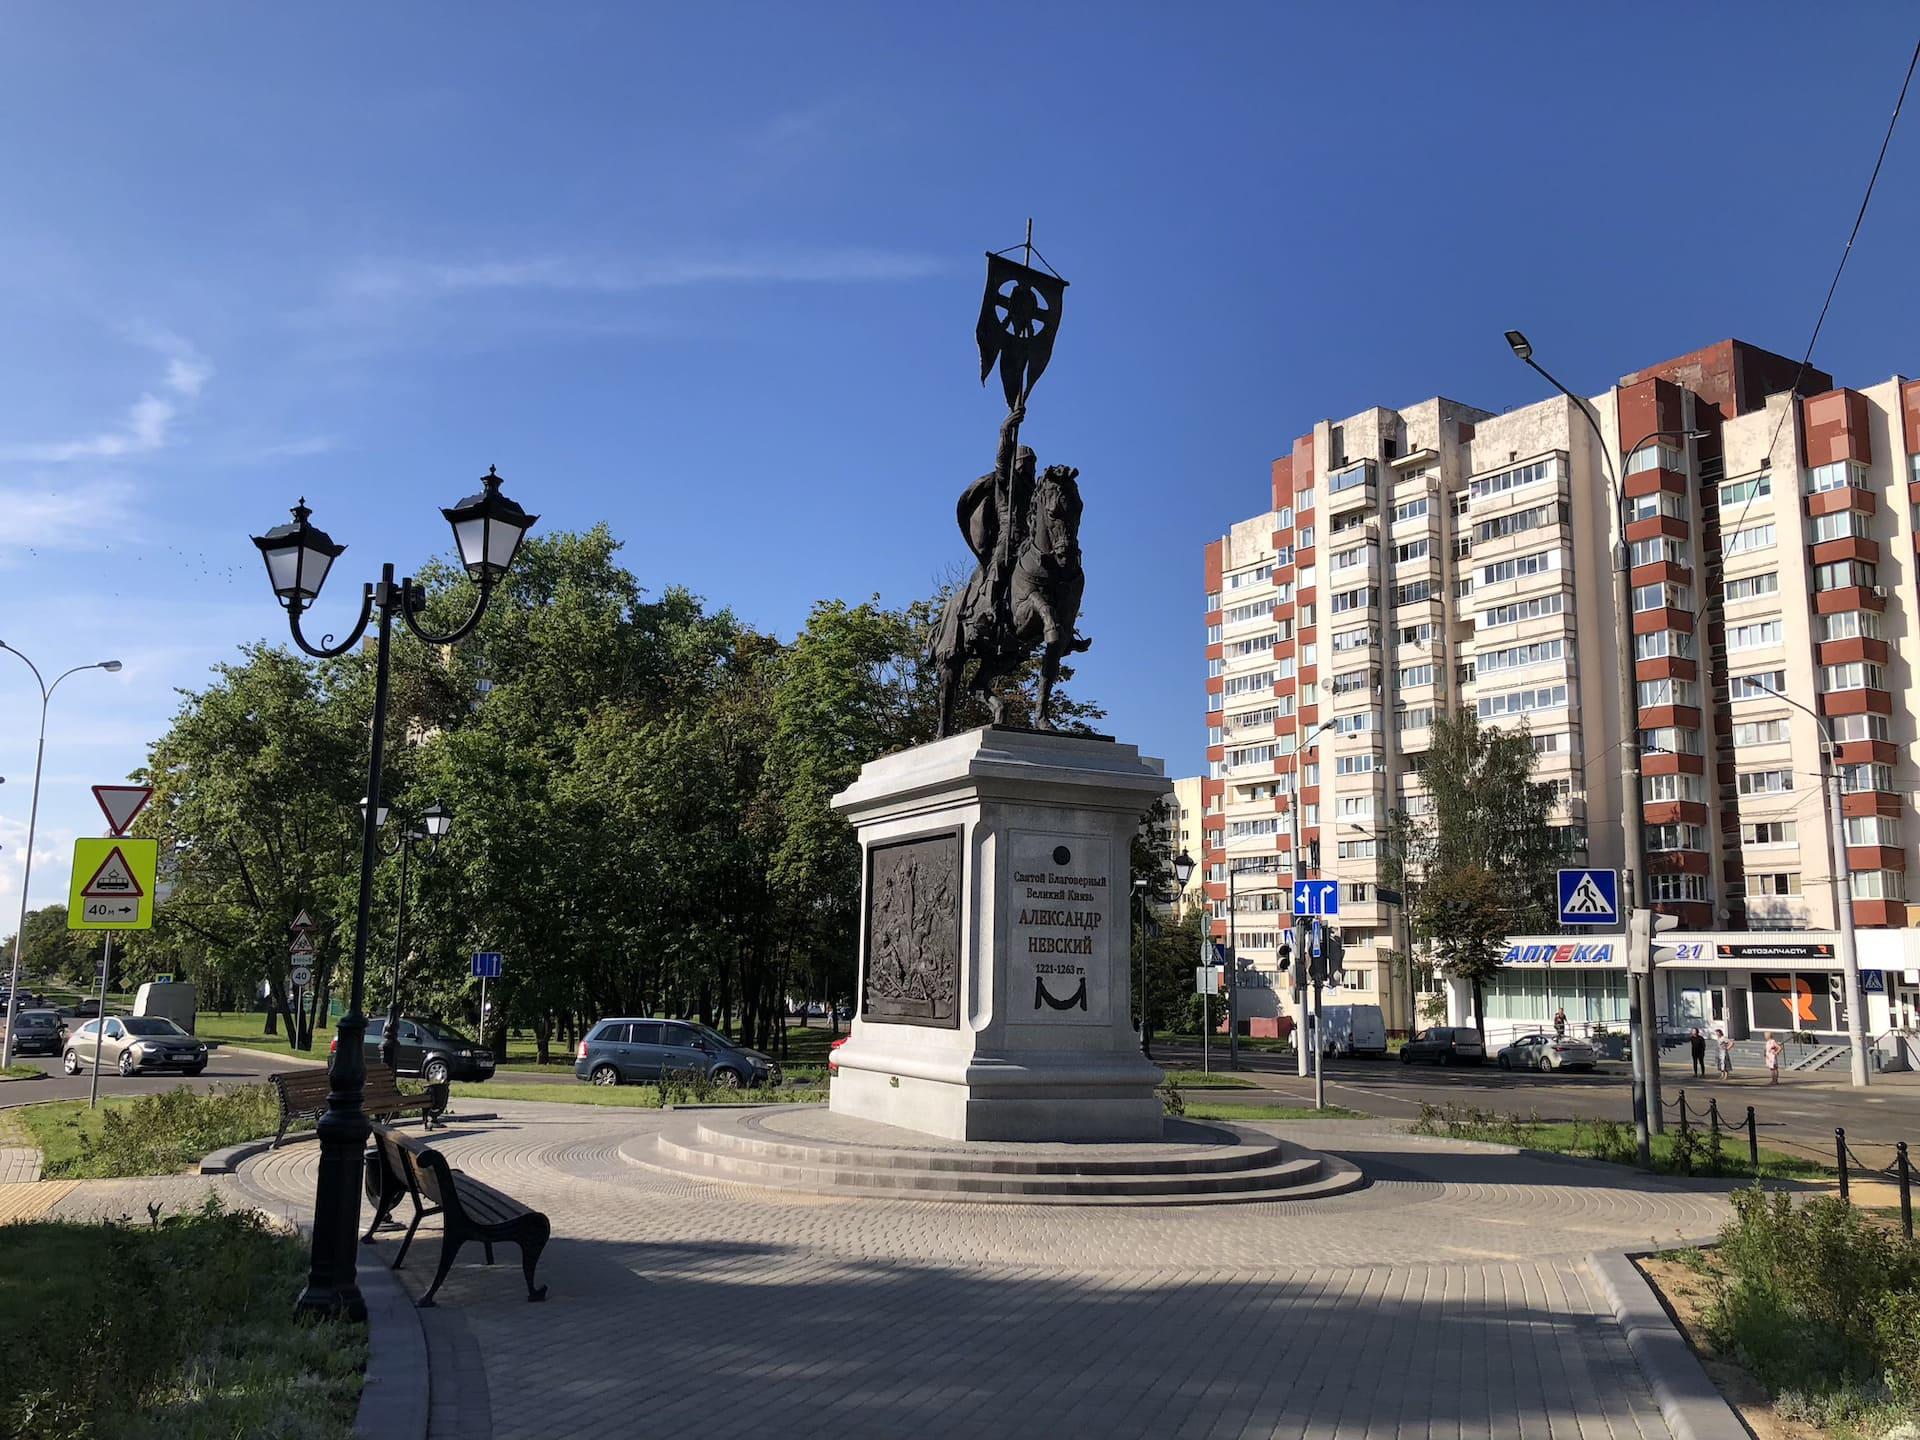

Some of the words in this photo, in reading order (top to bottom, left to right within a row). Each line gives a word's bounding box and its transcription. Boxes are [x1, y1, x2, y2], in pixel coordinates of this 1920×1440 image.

[1014, 871, 1045, 884] Святой
[1048, 872, 1106, 888] Благоверный
[1026, 887, 1065, 900] Великий
[1067, 889, 1094, 902] Князь
[1019, 908, 1101, 931] АЛЕКСАНДР
[1028, 935, 1092, 955] НЕВСКИЙ
[1503, 943, 1613, 963] АПТЕКА
[295, 972, 307, 980] 40
[1036, 963, 1075, 975] 1221-1263
